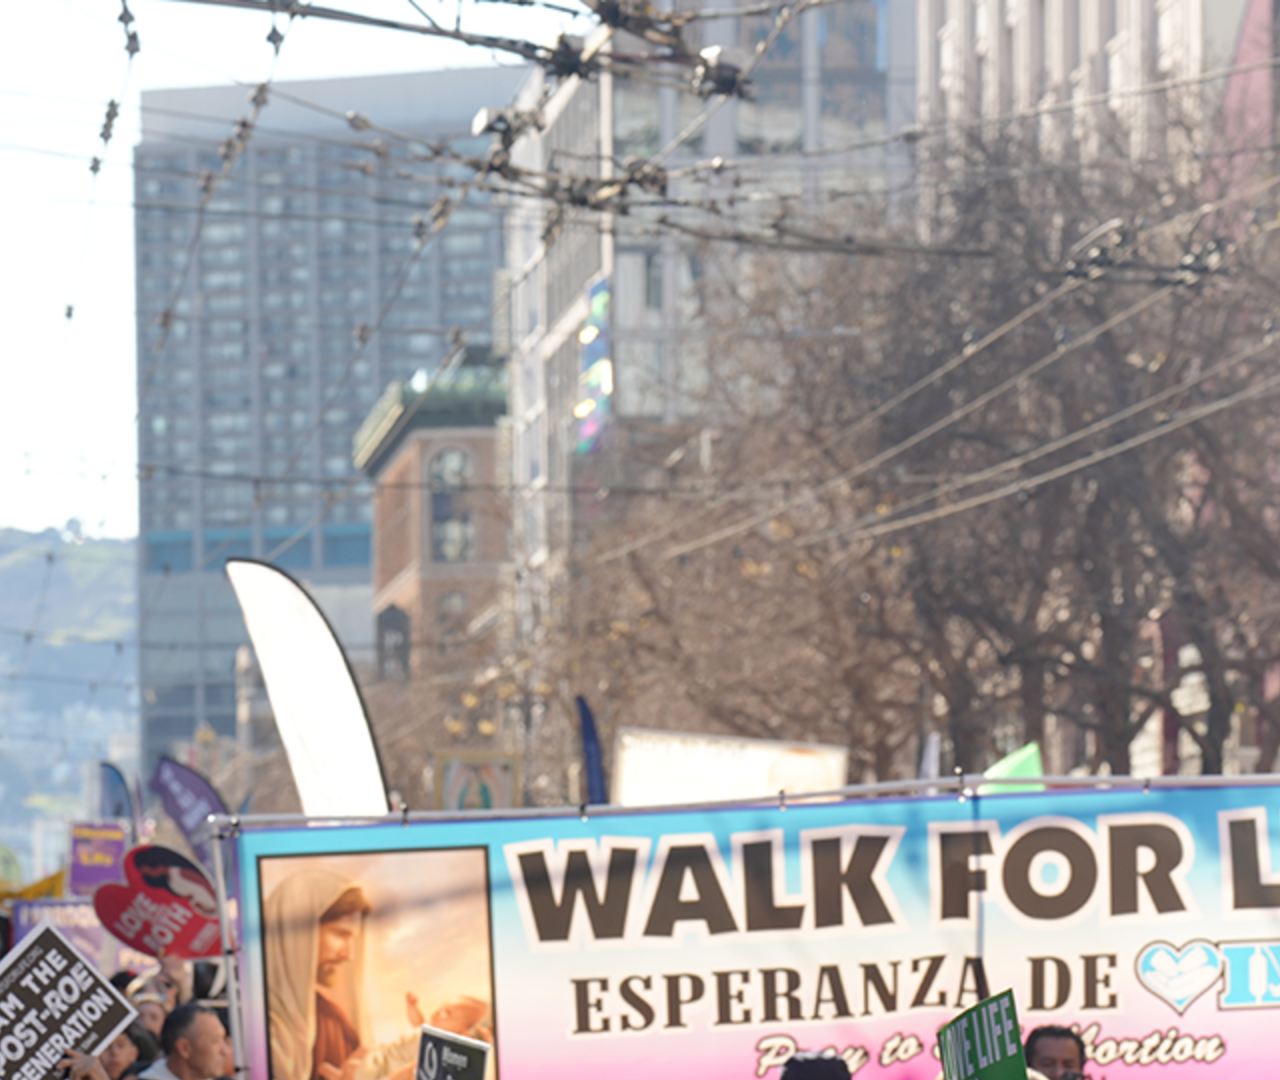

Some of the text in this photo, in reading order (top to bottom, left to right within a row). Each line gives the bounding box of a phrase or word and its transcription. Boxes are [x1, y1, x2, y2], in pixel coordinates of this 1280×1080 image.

[514, 833, 904, 944] WALK
[937, 819, 1189, 922] FOR
[20, 947, 69, 995] THE
[570, 955, 991, 1035] ESPERANZA
[1026, 953, 1120, 1012] DE
[879, 1032, 923, 1067] to
[971, 996, 1018, 1070] LIFE
[1074, 1020, 1226, 1066] bortion
